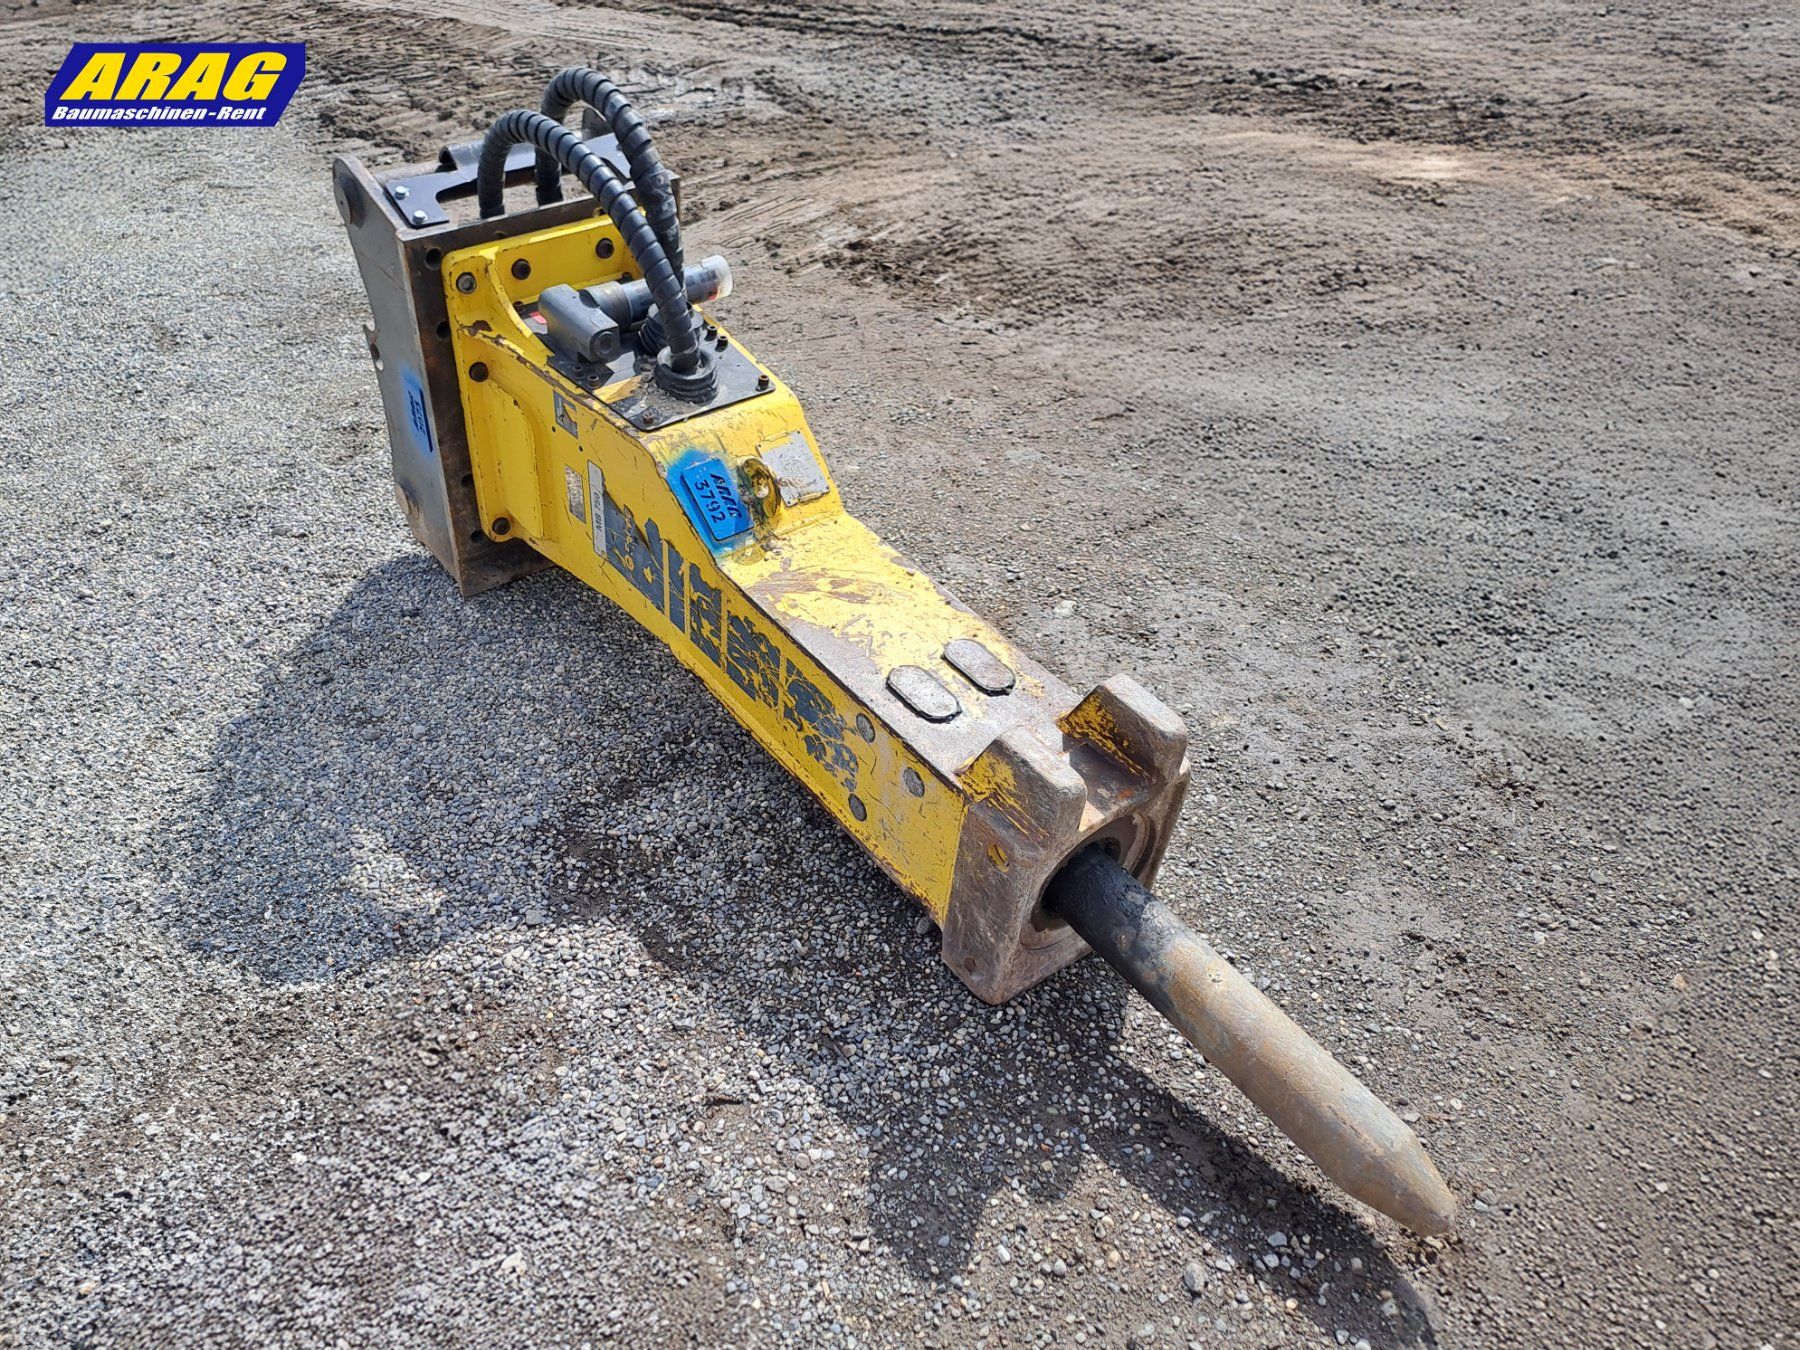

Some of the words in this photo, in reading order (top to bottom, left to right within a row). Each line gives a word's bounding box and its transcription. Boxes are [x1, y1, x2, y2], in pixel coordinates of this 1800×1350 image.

[593, 490, 601, 511] 750
[694, 478, 726, 524] 3792
[594, 512, 603, 532] MB
